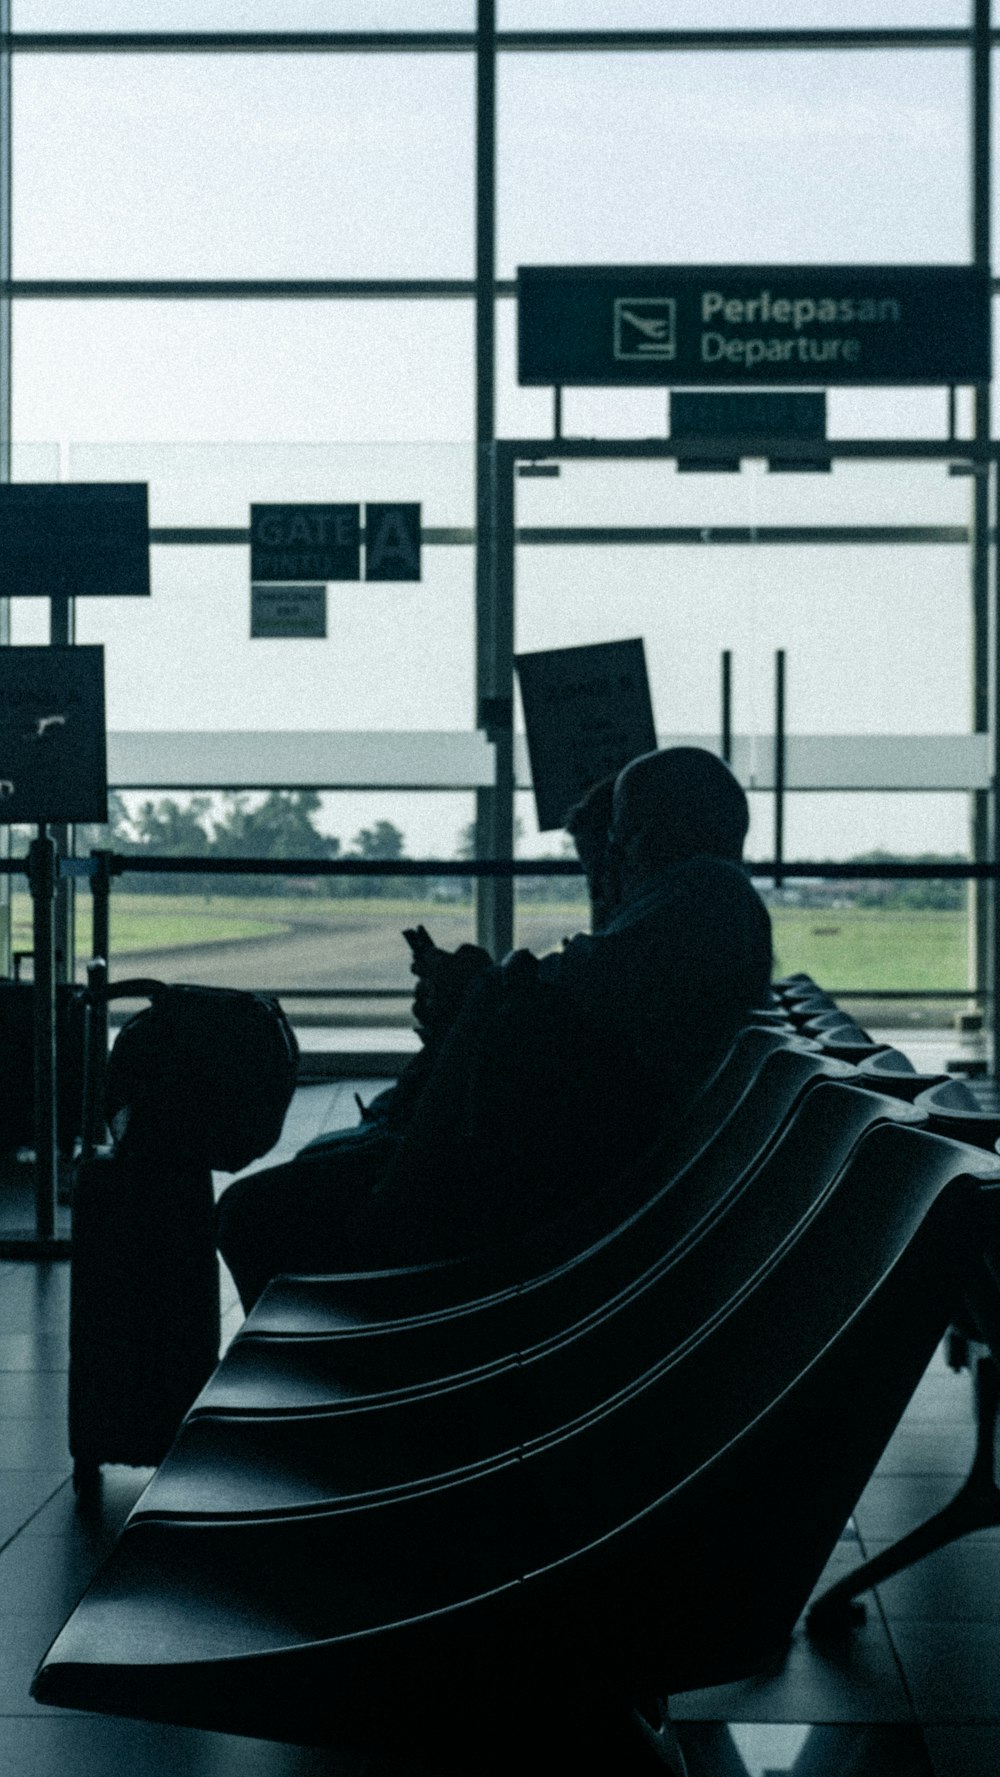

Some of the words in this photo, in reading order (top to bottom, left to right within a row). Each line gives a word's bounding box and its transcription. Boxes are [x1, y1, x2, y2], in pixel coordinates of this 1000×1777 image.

[701, 289, 900, 329] Perlepasan
[701, 333, 860, 368] Departure
[257, 512, 352, 546] GATE
[369, 510, 418, 570] A
